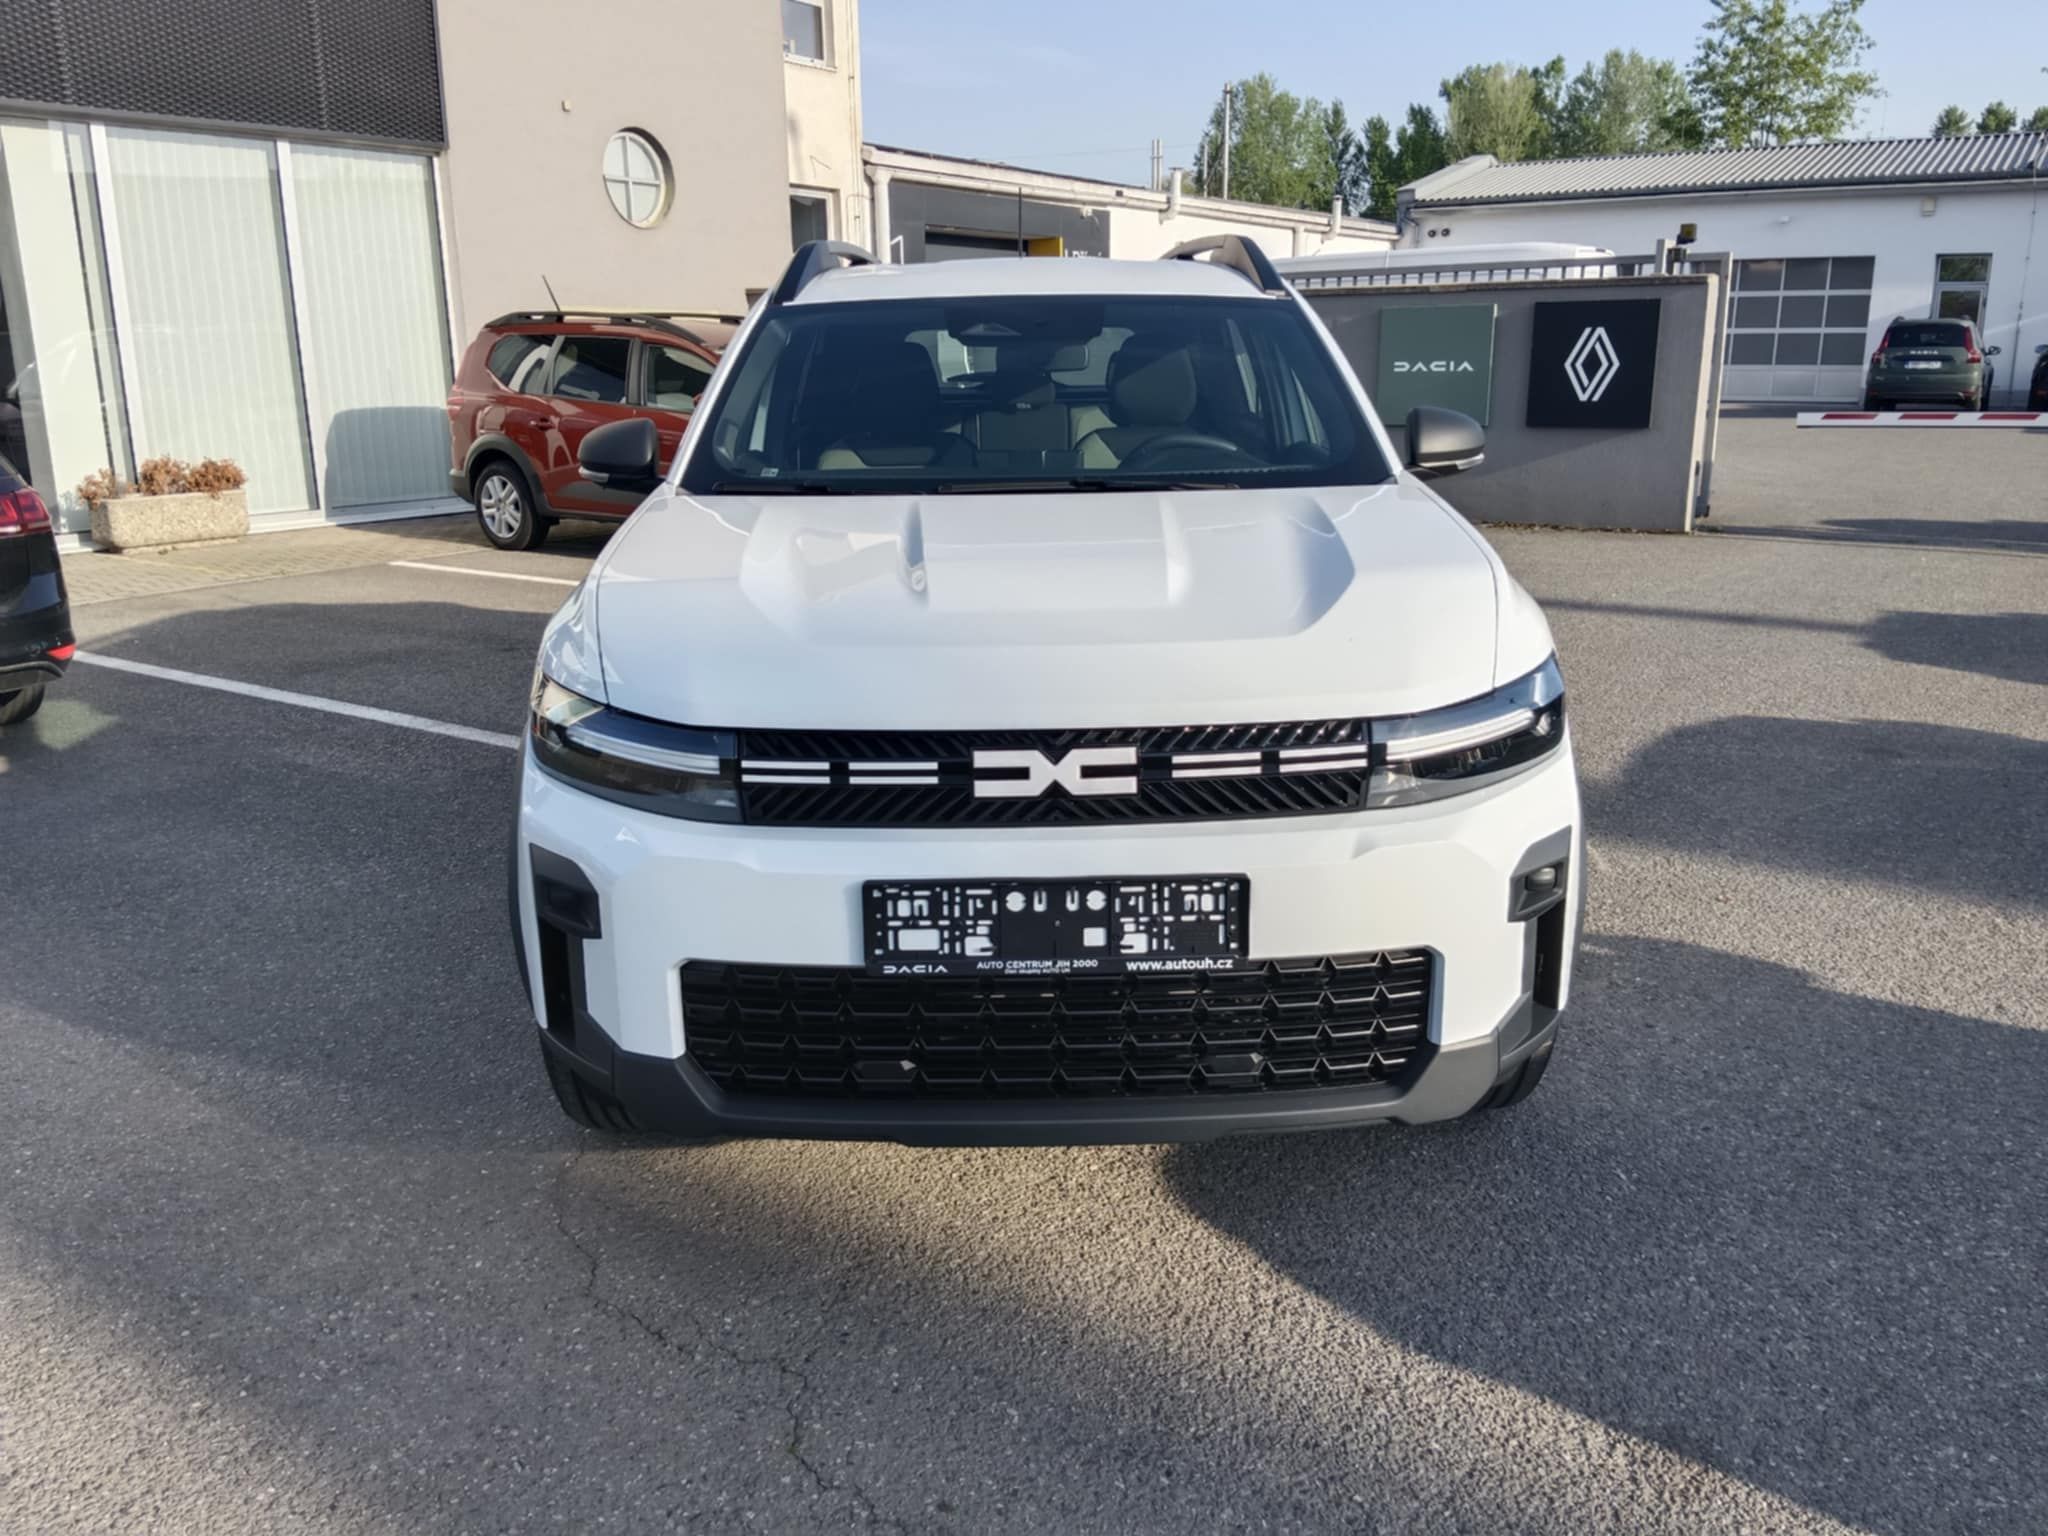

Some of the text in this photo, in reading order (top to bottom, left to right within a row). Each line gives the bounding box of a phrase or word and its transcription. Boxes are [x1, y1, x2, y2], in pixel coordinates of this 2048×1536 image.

[1393, 361, 1475, 372] DACIA
[977, 961, 1004, 969] AUTO
[1006, 960, 1053, 969] CENTRUM
[1072, 959, 1098, 968] 2000
[1126, 957, 1233, 971] www.autouh.cz
[883, 965, 948, 974] DACIA
